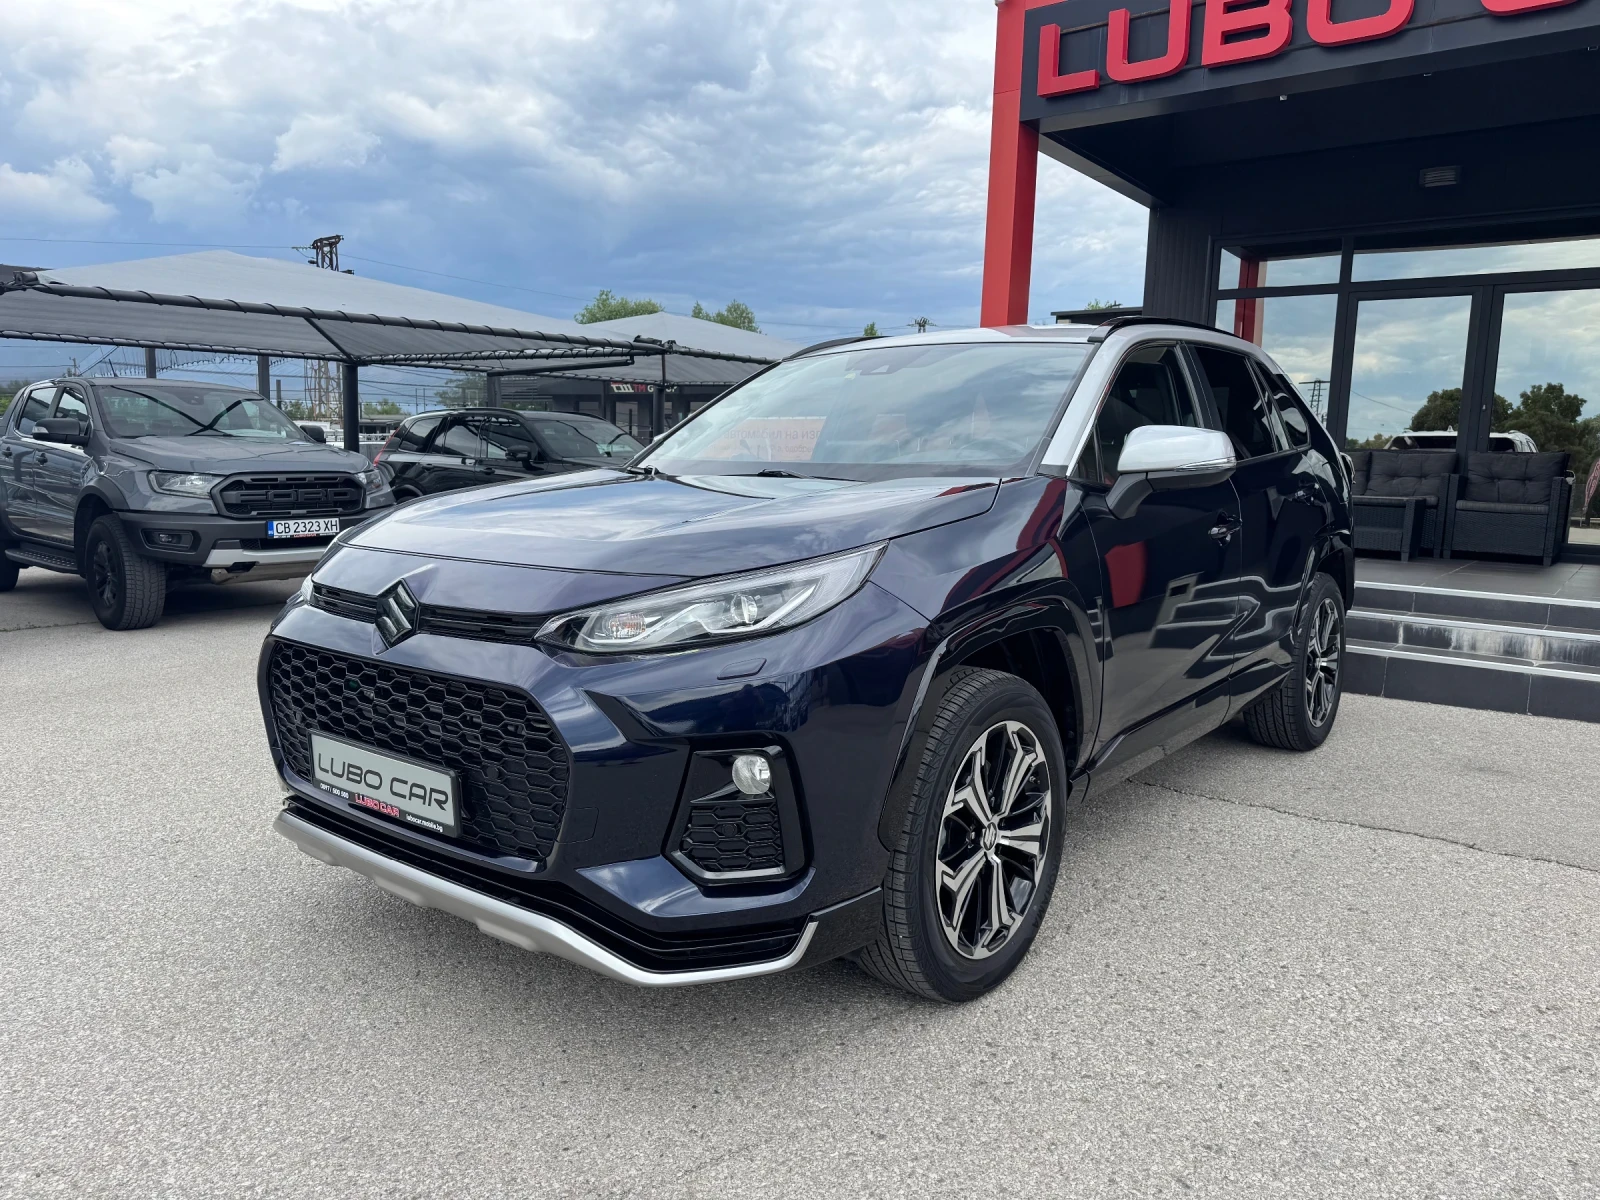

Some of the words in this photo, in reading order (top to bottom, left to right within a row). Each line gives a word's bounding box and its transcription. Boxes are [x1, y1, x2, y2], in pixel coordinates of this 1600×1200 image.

[1037, 0, 1415, 98] LUBO
[633, 383, 646, 393] TM
[647, 384, 678, 393] GUP
[785, 430, 799, 440] на
[222, 488, 358, 503] FORD
[275, 522, 291, 534] CB
[293, 520, 321, 533] 2323
[323, 519, 338, 532] XH
[318, 752, 383, 791] LUBO
[389, 776, 449, 811] CAR
[355, 794, 380, 810] LUBO
[380, 802, 399, 818] CAR
[1032, 843, 1063, 929] YOKOHAMA
